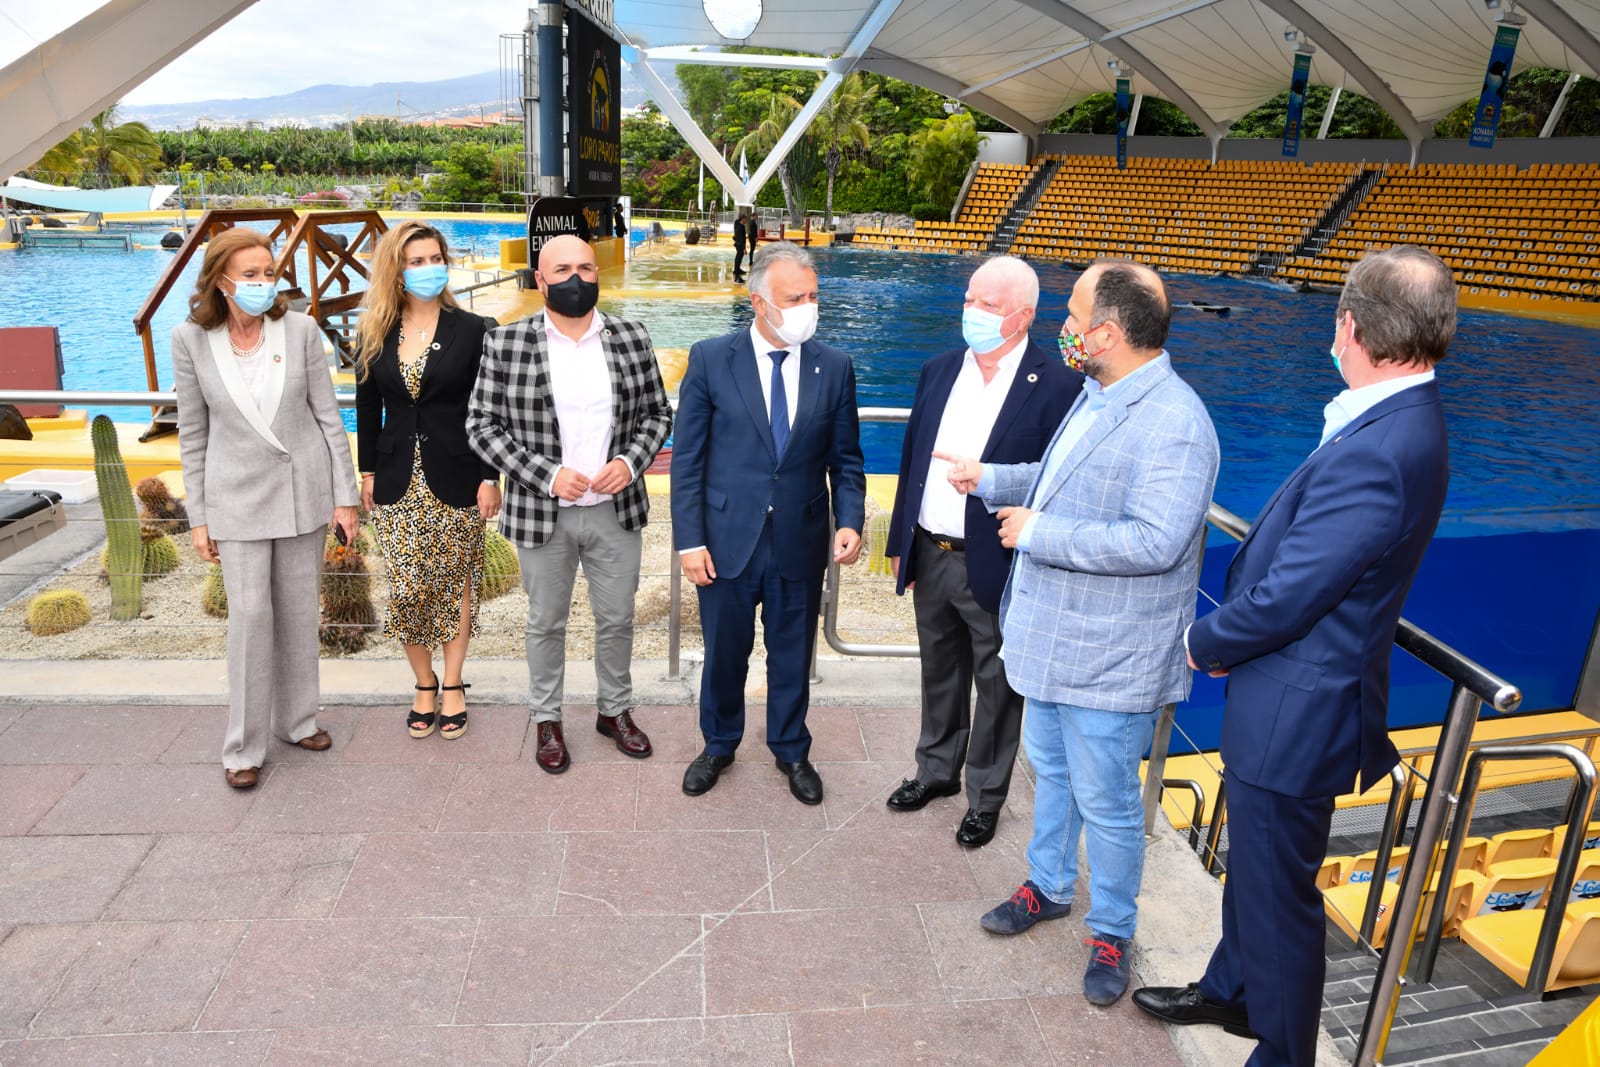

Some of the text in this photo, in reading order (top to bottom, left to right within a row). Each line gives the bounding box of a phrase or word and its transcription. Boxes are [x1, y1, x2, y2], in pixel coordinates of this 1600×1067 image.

[579, 135, 619, 166] LORO PARQUE
[535, 215, 577, 232] ANIMAL
